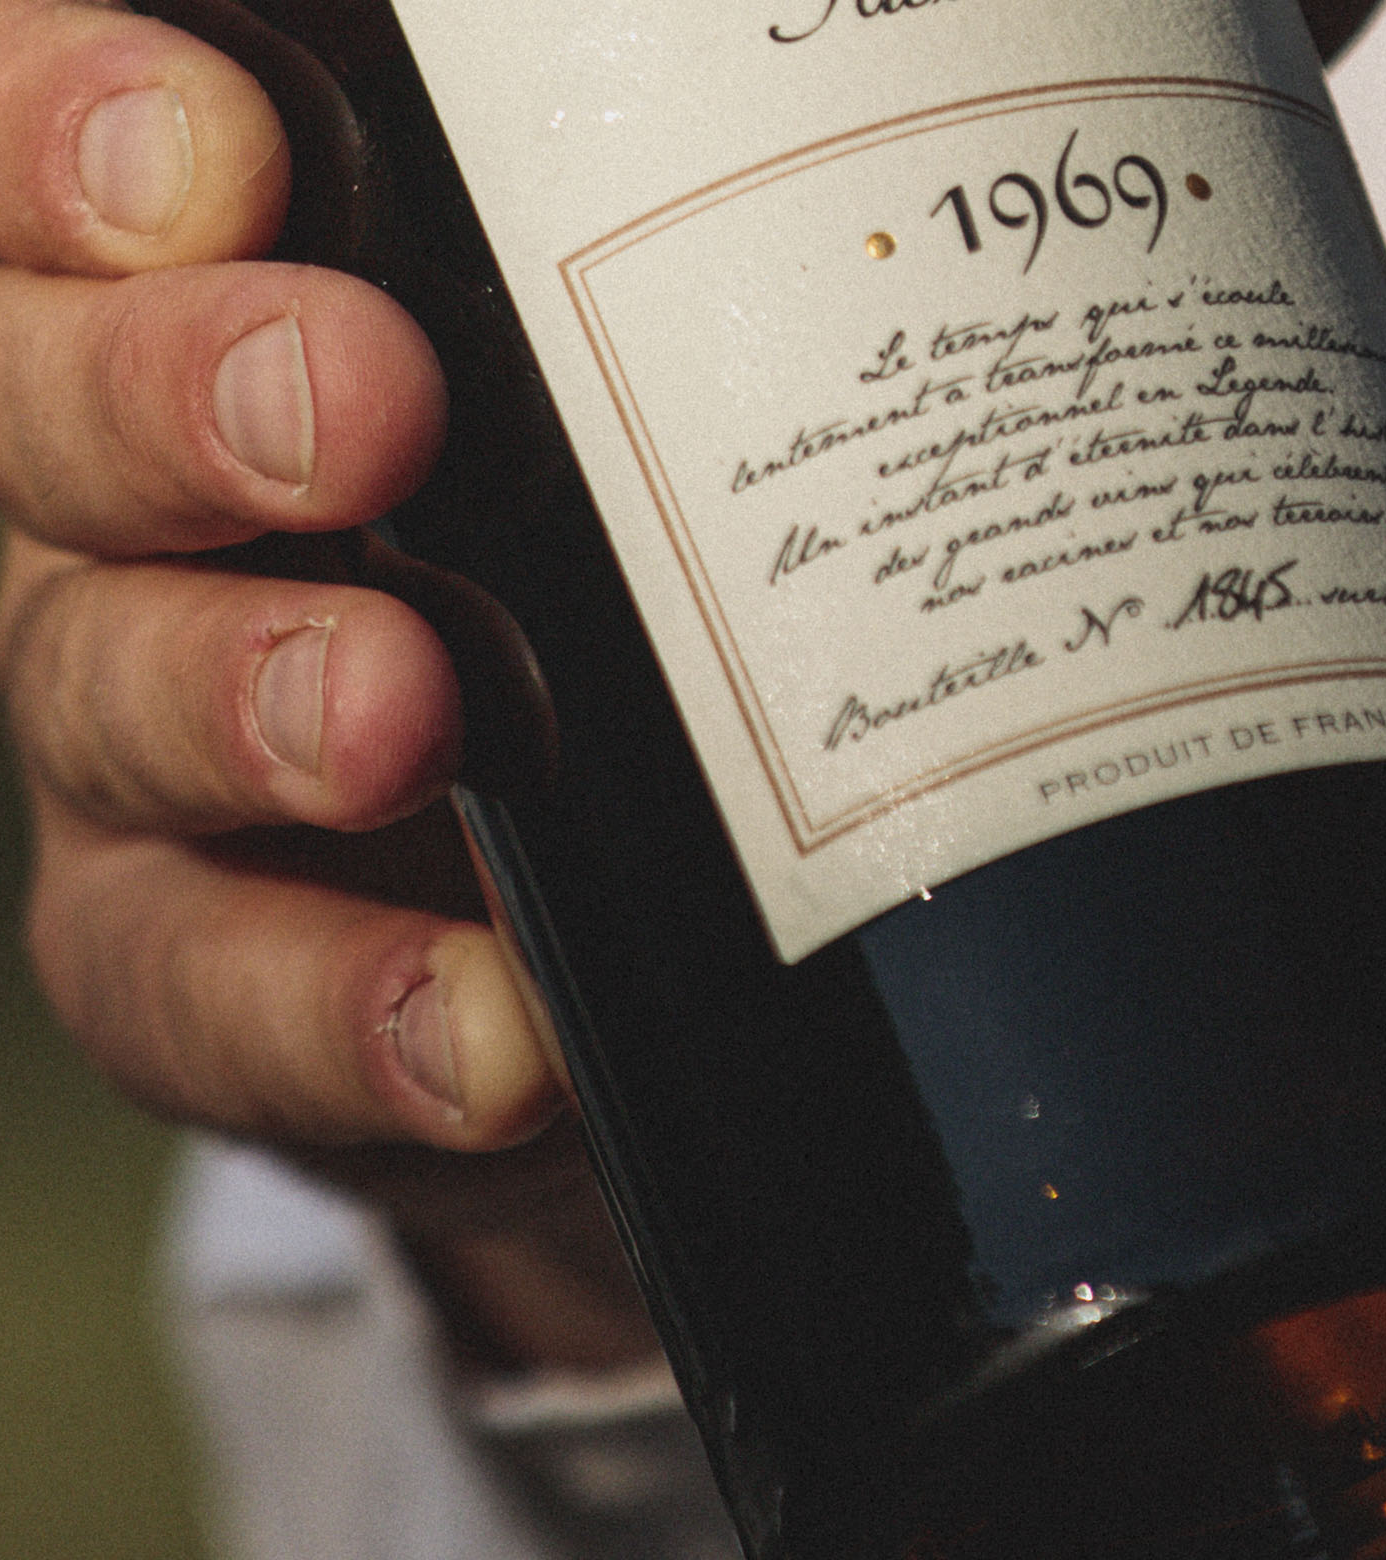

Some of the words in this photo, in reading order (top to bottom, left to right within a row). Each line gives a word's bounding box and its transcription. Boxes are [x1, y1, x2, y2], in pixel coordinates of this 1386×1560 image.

[929, 127, 1169, 276] 1969
[859, 329, 916, 383] Le
[929, 310, 1060, 362] temps
[1079, 279, 1158, 344] qui
[731, 376, 965, 494] lentement
[1212, 333, 1243, 349] ce
[877, 383, 1125, 495] exceptionnel
[1137, 386, 1183, 405] en
[858, 454, 1017, 537] instant
[1222, 415, 1301, 442] dans
[873, 545, 931, 585] des
[933, 491, 1076, 591] grands
[1192, 450, 1263, 512] qui
[920, 575, 987, 614] nos
[1001, 532, 1138, 583] racines
[1151, 507, 1204, 543] et
[1200, 512, 1260, 535] nos
[823, 640, 1046, 752] Bouteille
[1038, 734, 1212, 805] PRODUIT
[1229, 721, 1280, 751] DE
